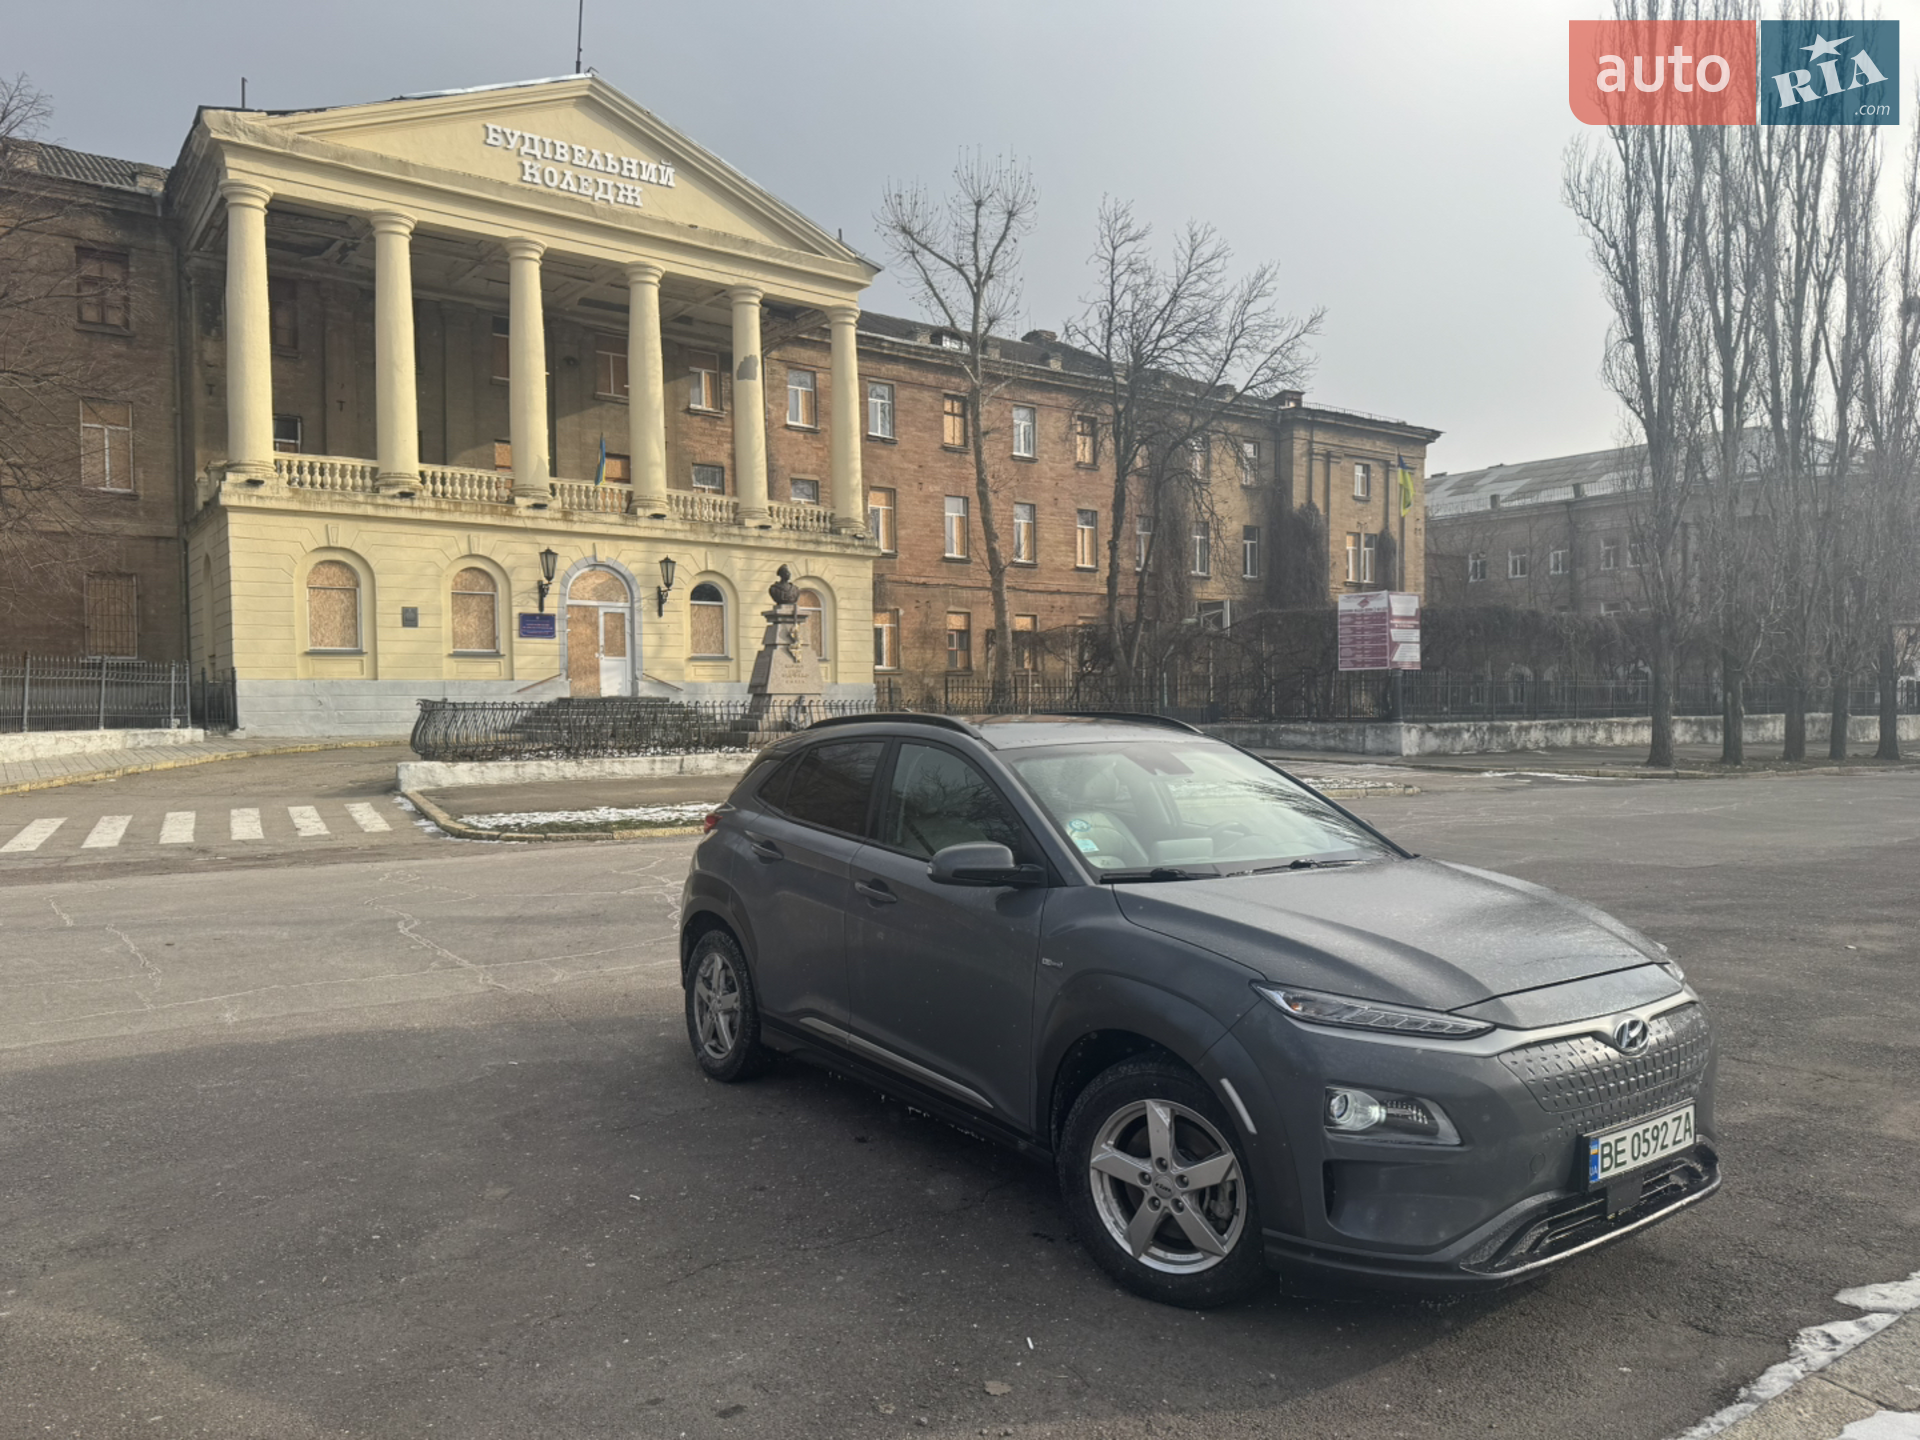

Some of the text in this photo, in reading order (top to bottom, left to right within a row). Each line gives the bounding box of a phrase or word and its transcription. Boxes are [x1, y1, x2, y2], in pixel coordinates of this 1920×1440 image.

[485, 123, 676, 188] БУДІВЕЛЬНИЙ
[521, 160, 644, 207] КОЛЕДЖ
[1600, 1111, 1693, 1174] BE 0592 ZA
